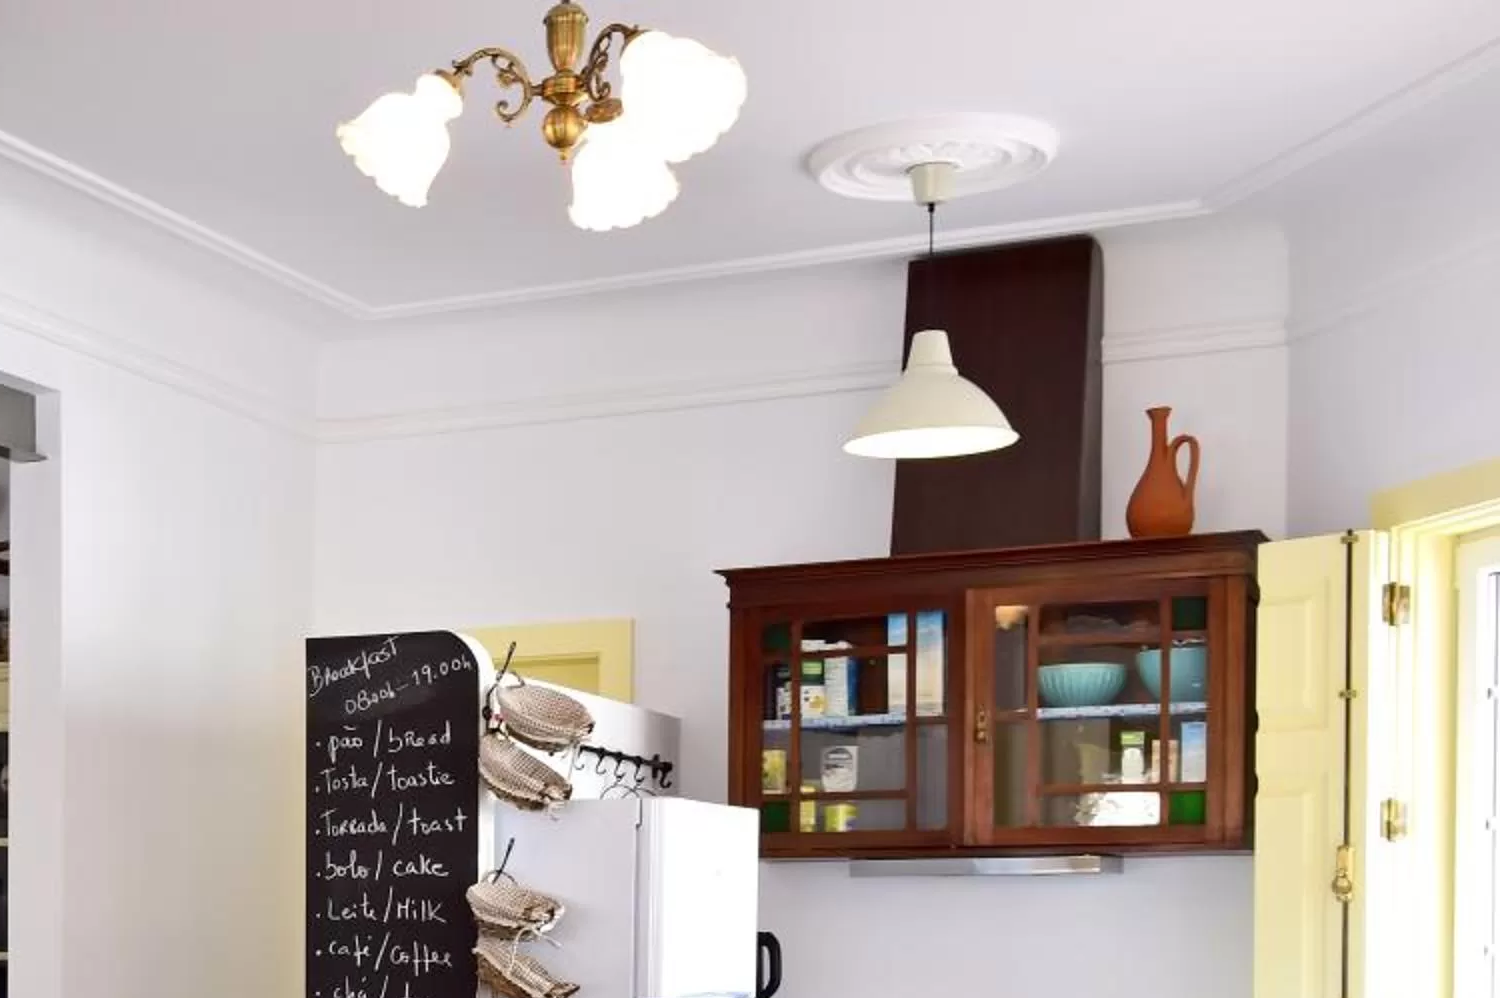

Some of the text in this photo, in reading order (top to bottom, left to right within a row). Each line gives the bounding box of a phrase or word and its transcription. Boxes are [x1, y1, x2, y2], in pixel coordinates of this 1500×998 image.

[327, 725, 363, 763] pão
[408, 807, 469, 836] toast
[393, 853, 450, 878] cake
